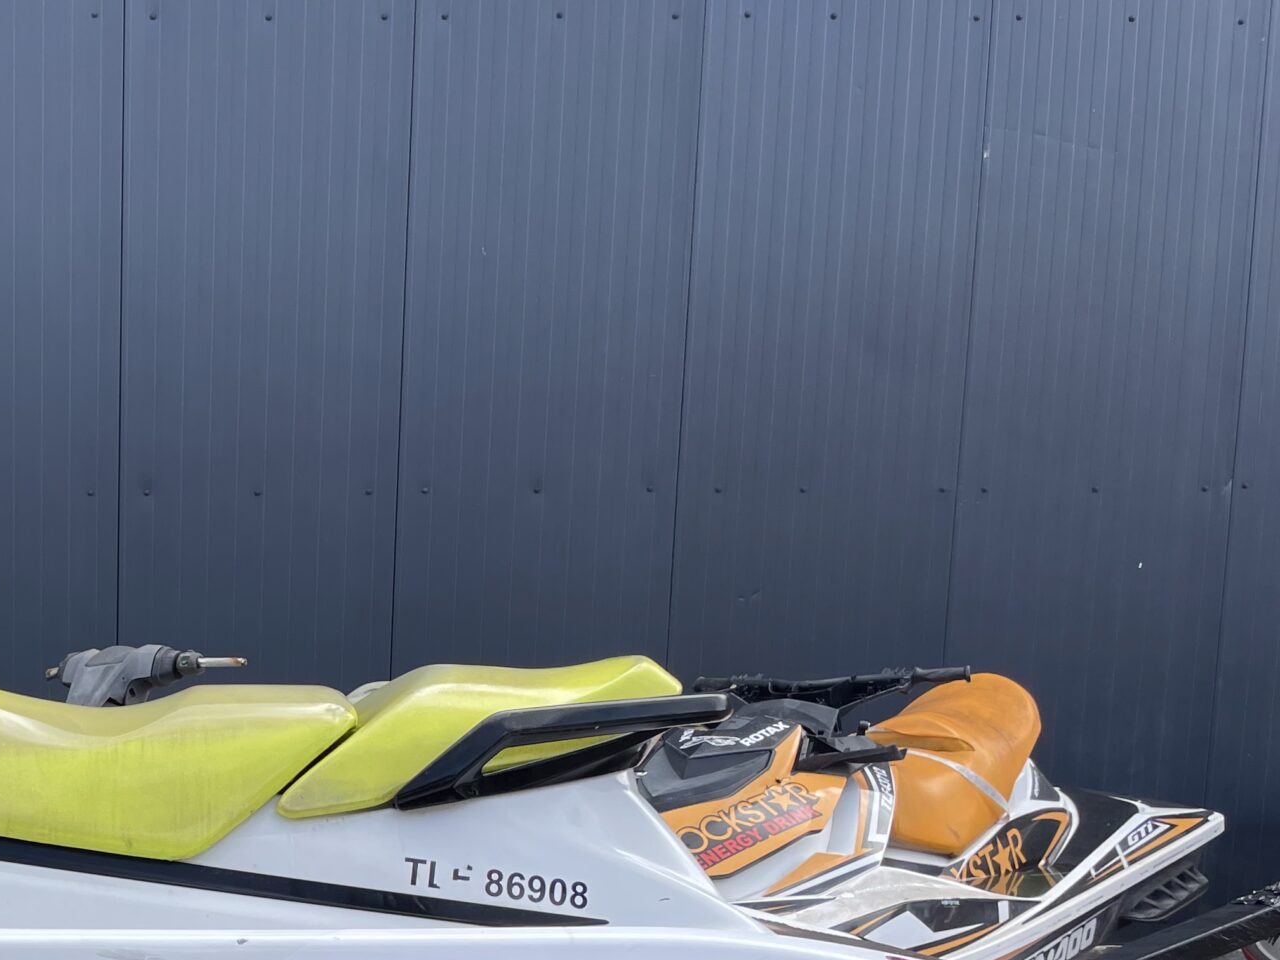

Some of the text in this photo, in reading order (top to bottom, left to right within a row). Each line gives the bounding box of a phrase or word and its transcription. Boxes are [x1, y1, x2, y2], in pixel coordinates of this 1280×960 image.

[739, 721, 790, 747] ROTAX
[764, 805, 822, 836] DRINK
[485, 869, 588, 909] 86908
